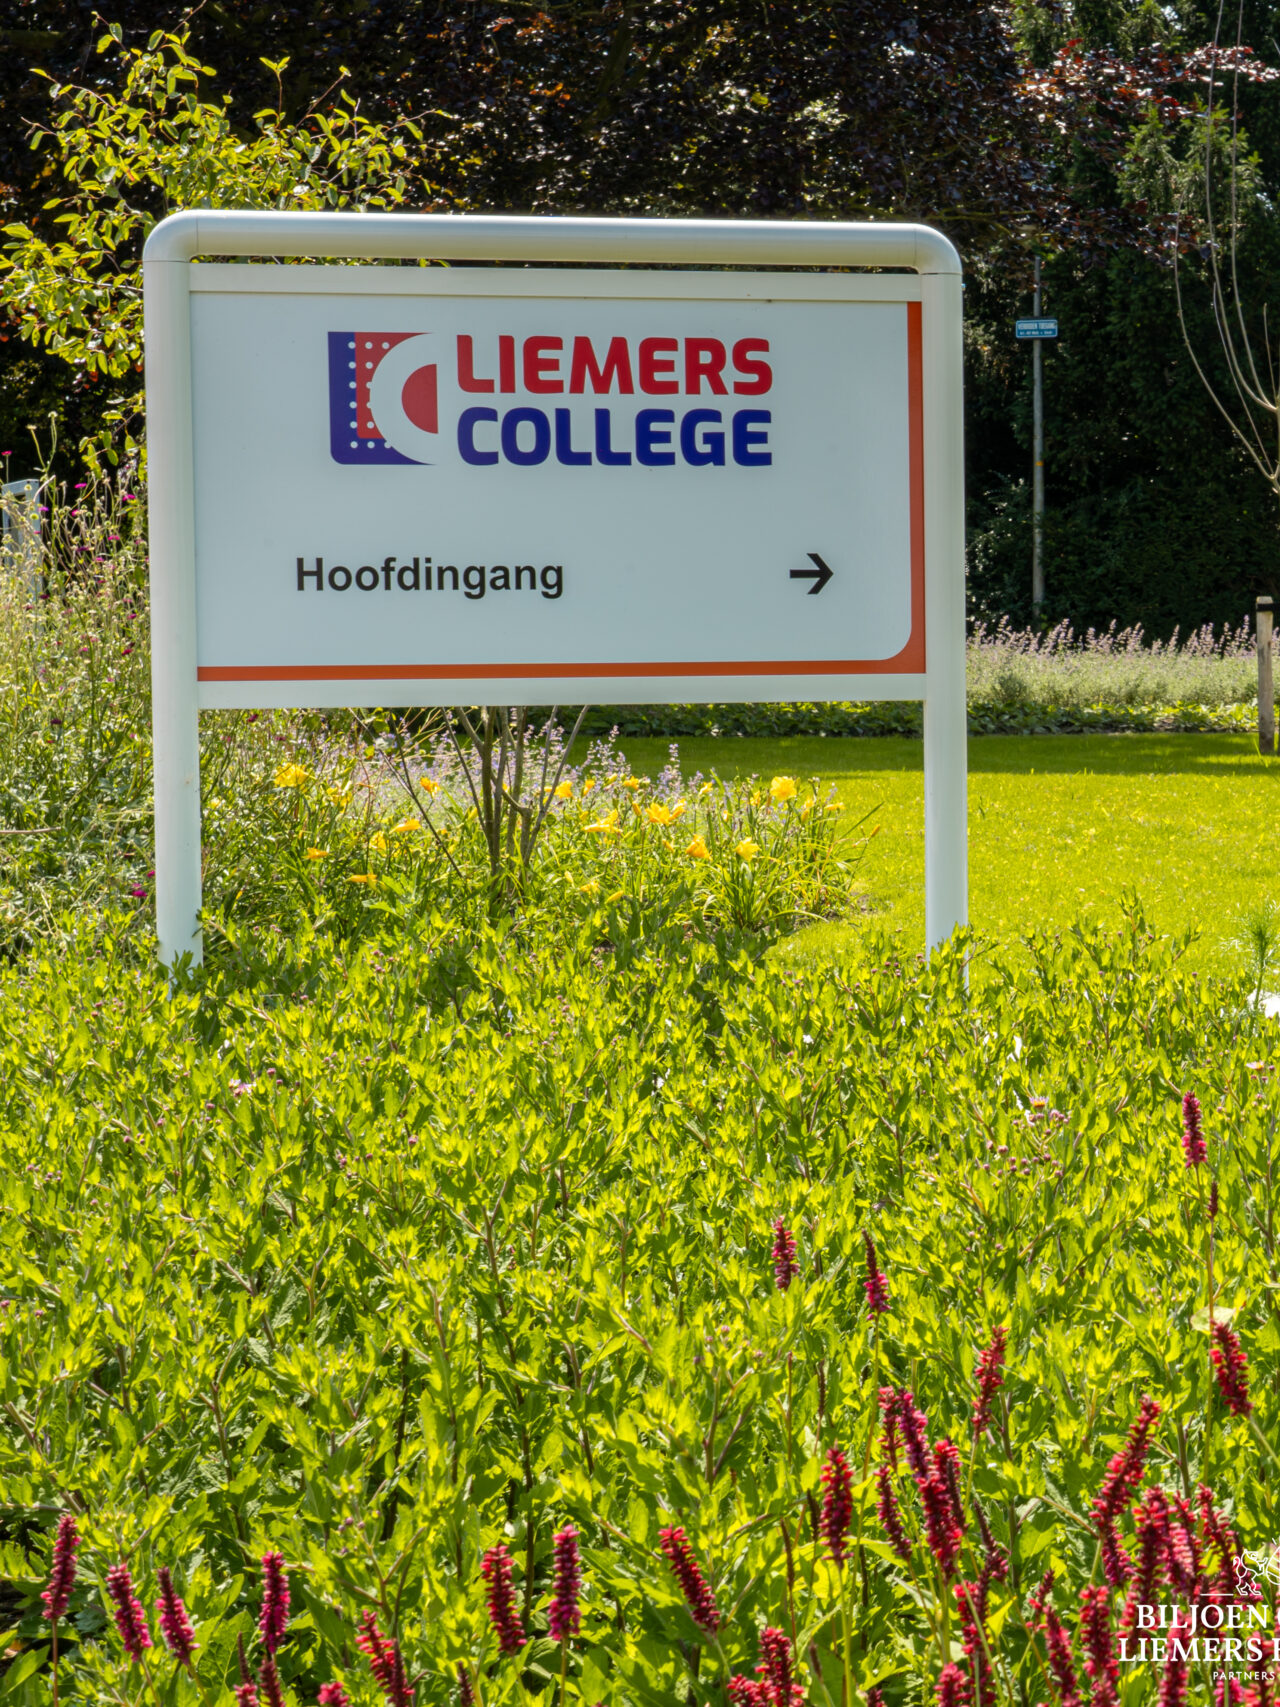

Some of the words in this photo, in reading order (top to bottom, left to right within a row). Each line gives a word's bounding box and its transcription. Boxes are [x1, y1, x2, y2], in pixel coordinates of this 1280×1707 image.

[457, 336, 773, 396] LIEMERS
[458, 407, 772, 467] COLLEGE
[297, 557, 563, 600] Hoofdingang
